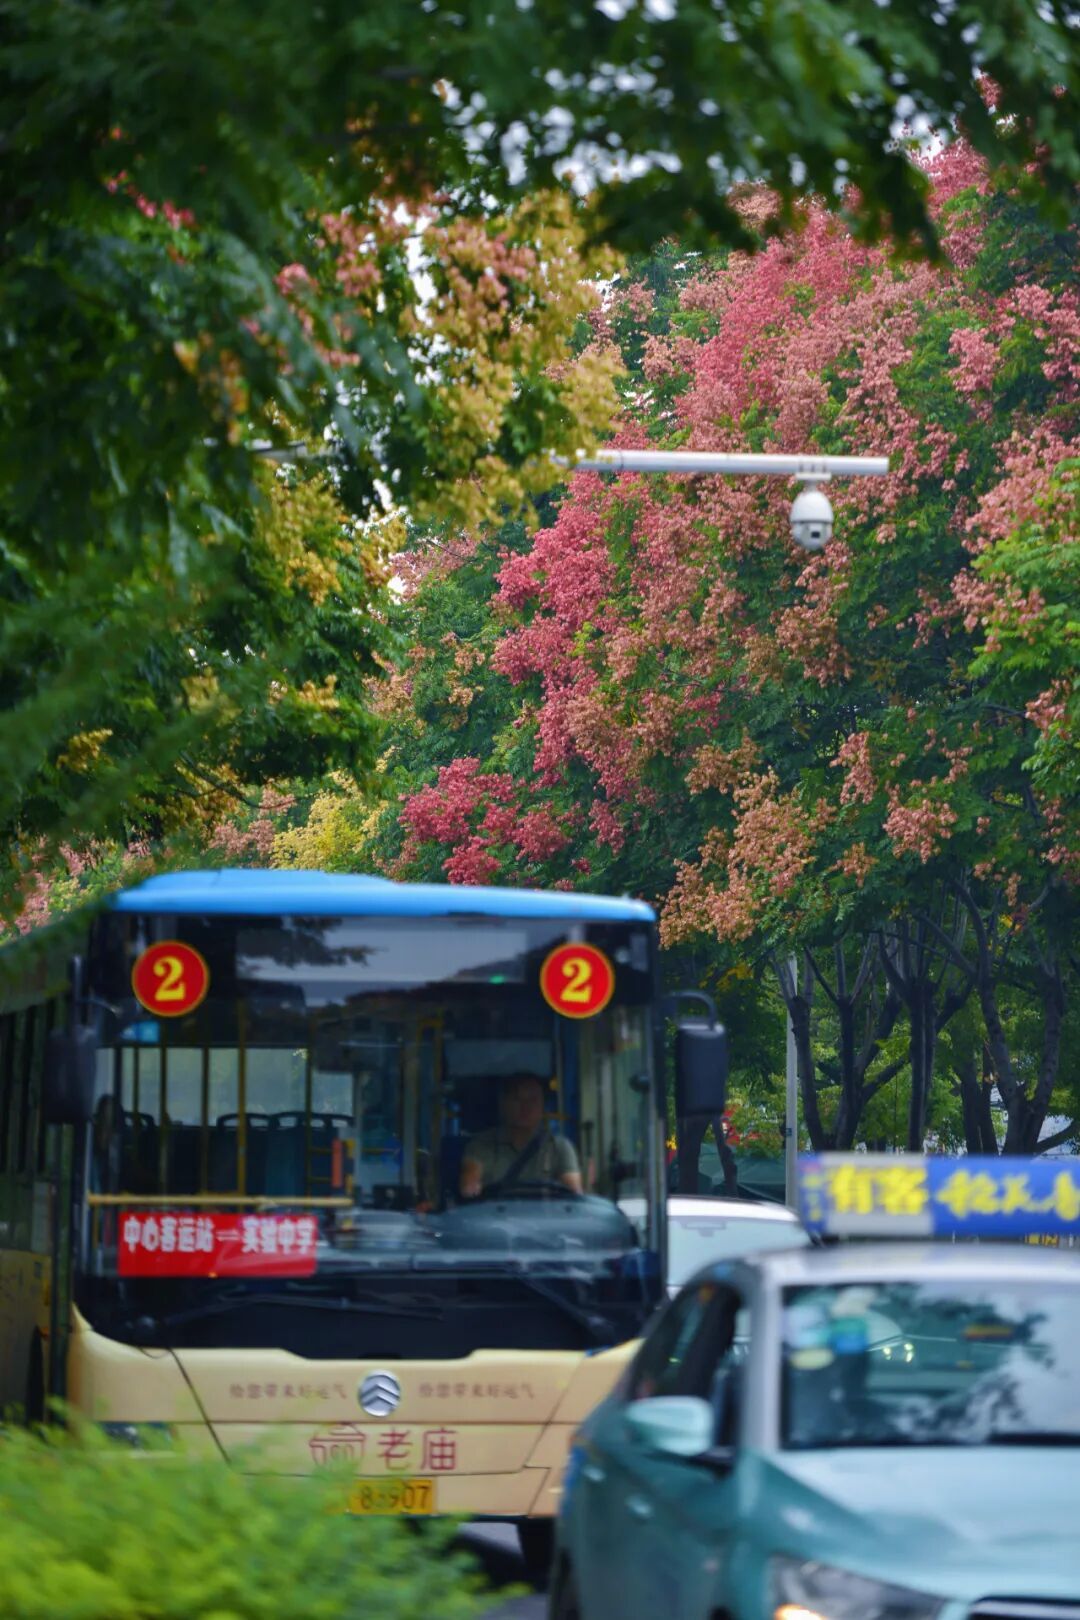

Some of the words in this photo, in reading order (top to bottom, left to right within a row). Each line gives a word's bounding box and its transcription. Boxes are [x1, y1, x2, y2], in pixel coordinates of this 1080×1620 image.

[152, 956, 186, 1001] 2
[560, 958, 593, 1003] 2
[377, 1426, 457, 1471] 老庙
